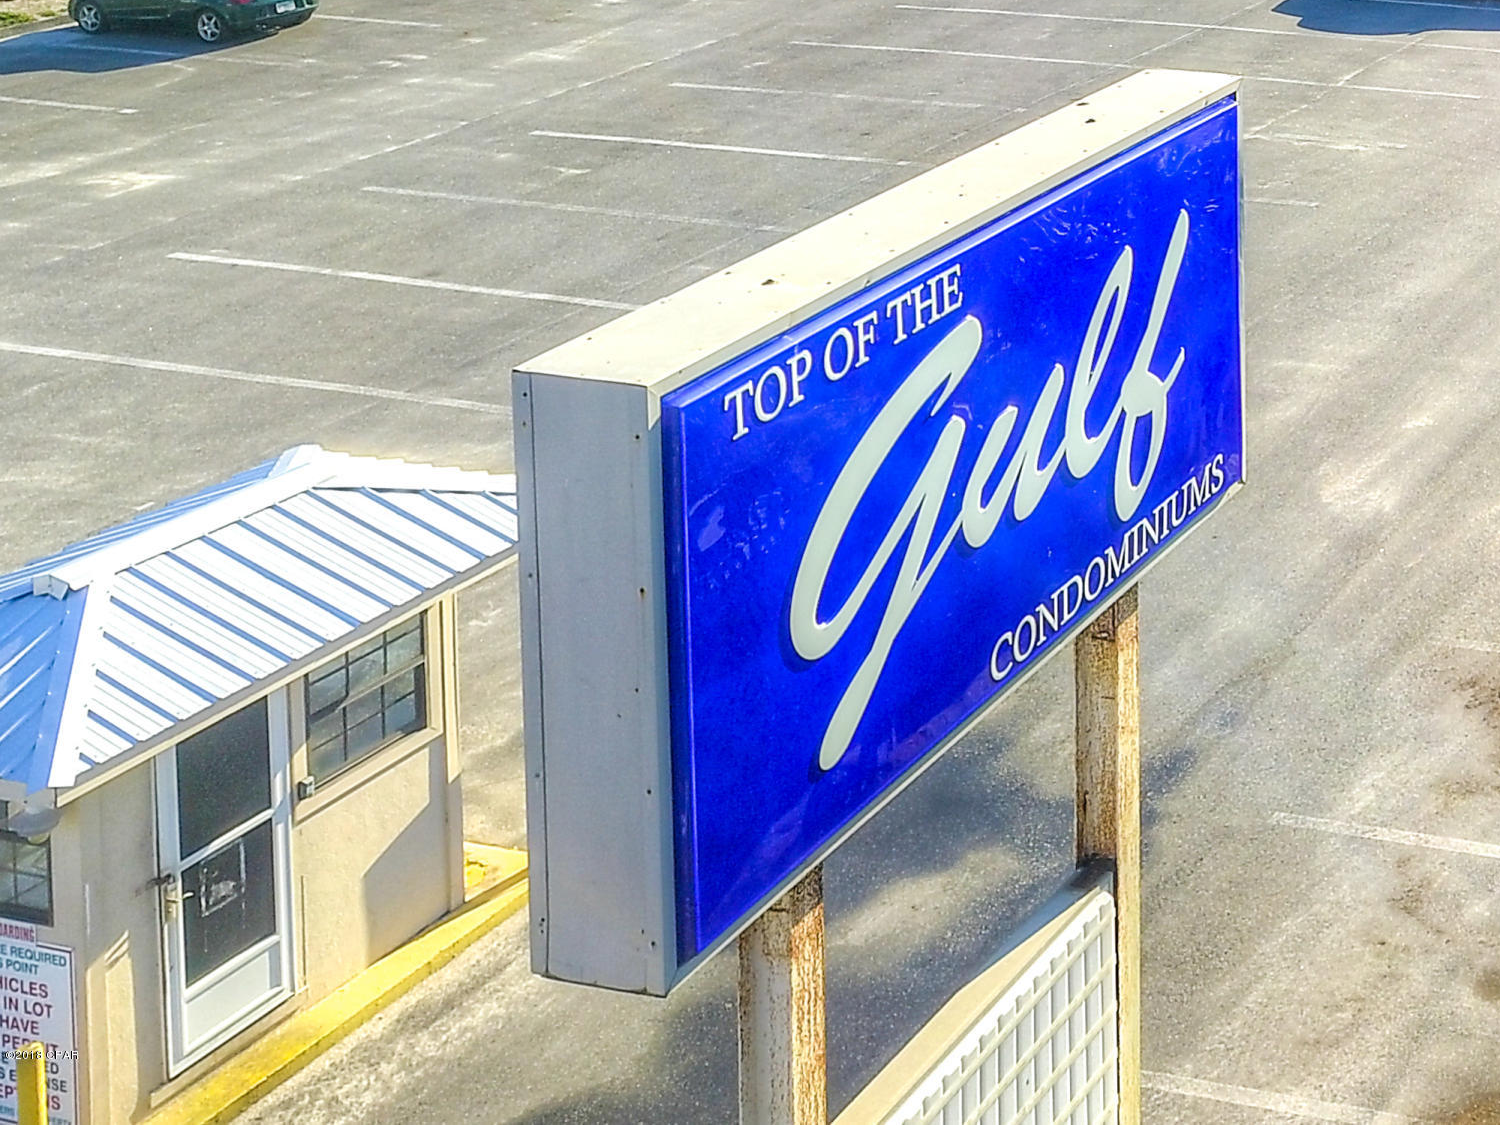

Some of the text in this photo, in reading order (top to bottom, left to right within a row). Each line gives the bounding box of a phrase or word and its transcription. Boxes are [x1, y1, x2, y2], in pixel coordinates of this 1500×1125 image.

[724, 263, 963, 441] TOP OF THE
[990, 453, 1225, 681] CONDOMINIUMS
[6, 959, 39, 975] POINT
[10, 946, 67, 967] REQUIRED
[4, 995, 53, 1019] IN LOT
